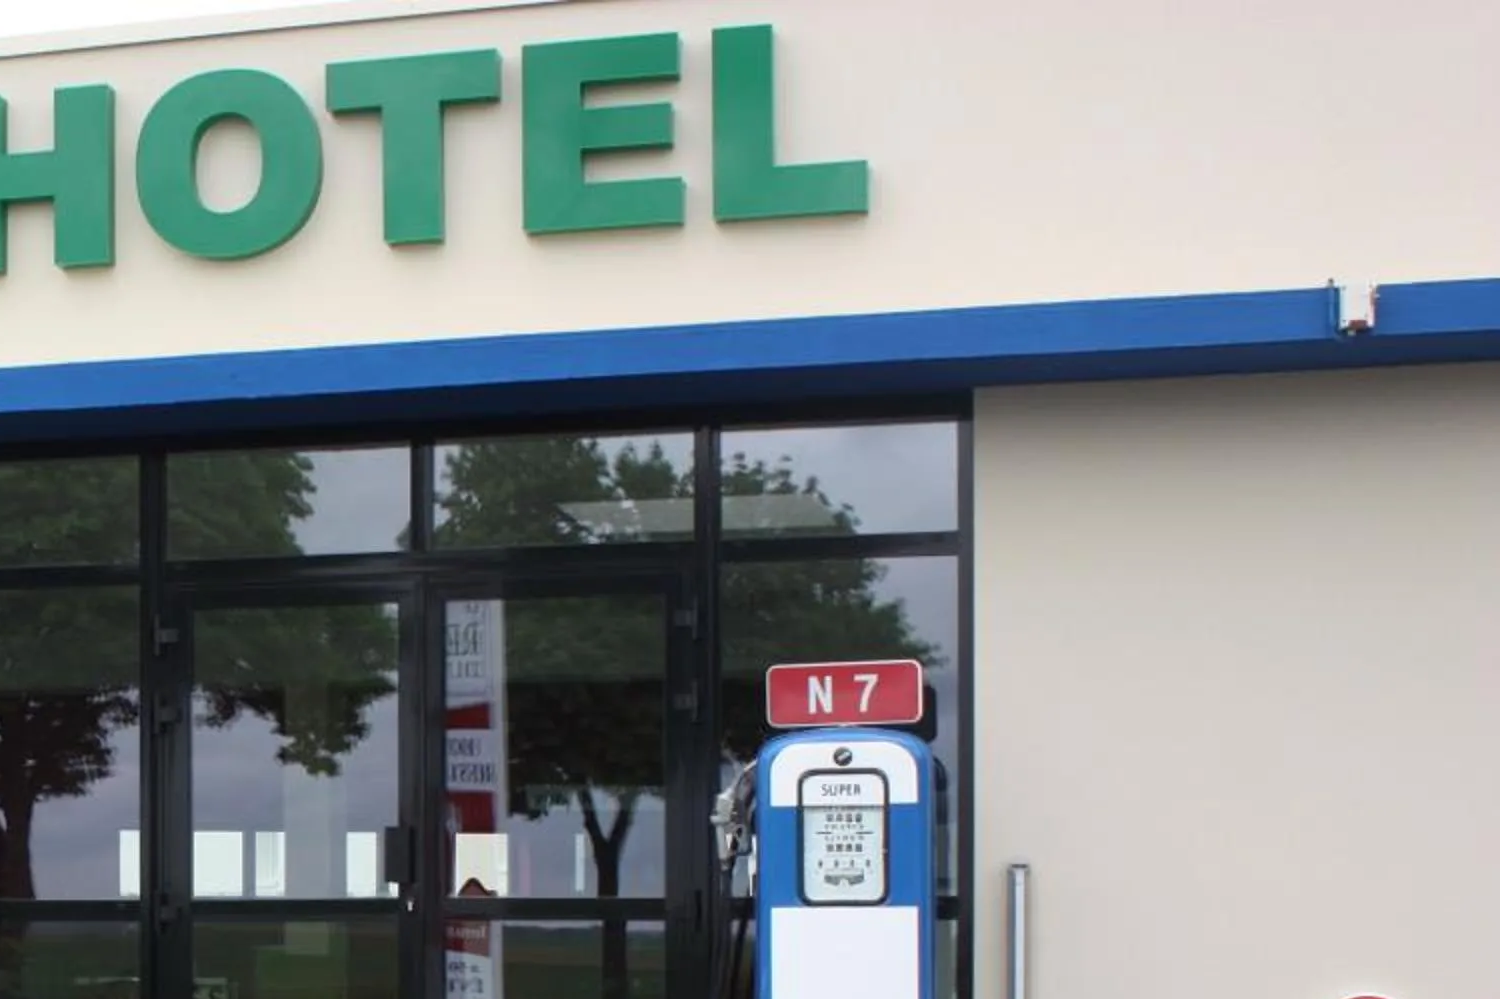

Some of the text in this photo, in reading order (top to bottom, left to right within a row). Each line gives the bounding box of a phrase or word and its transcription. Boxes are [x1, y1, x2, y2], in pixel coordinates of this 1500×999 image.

[808, 673, 879, 715] N 7
[820, 783, 861, 797] SUPER
